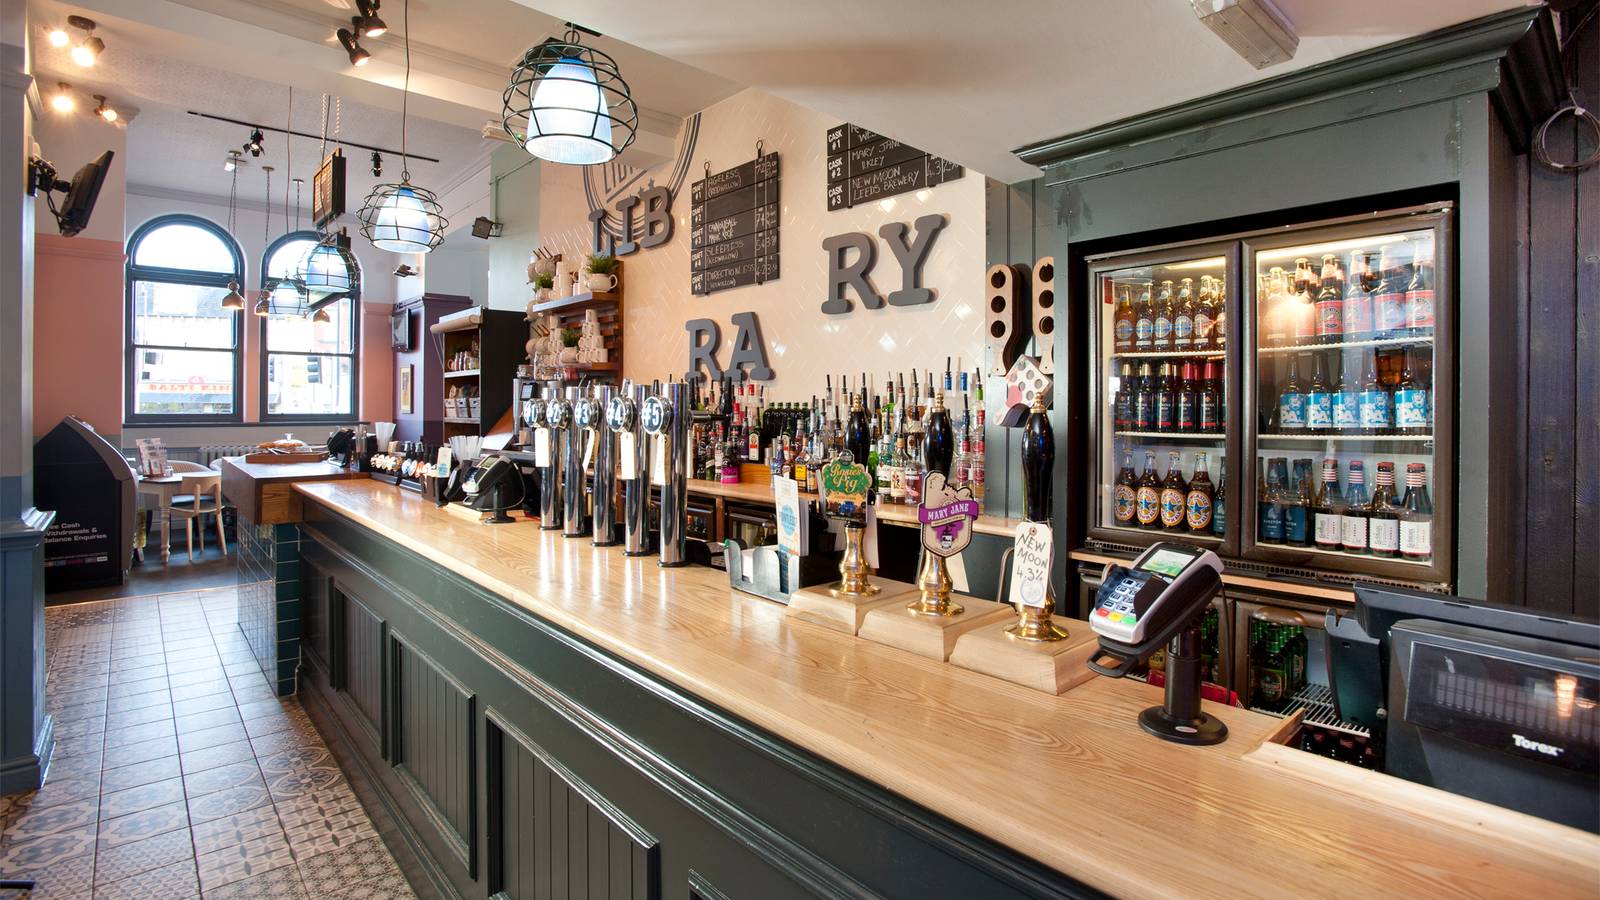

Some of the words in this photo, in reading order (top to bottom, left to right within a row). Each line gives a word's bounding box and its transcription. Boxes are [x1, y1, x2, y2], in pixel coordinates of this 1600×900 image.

[828, 129, 843, 143] CASK
[831, 140, 841, 151] #1
[828, 157, 843, 171] CASK
[831, 167, 842, 179] #2
[852, 177, 871, 190] NEW
[873, 166, 901, 184] MOON
[828, 184, 843, 198] CASK
[853, 185, 881, 200] LEEDS
[883, 170, 920, 191] BREWERY
[831, 194, 842, 206] #3
[588, 186, 673, 258] LIB
[692, 228, 704, 239] CRAFT
[695, 236, 702, 246] #3
[692, 251, 704, 262] CRAFT
[695, 259, 702, 268] #4
[821, 214, 947, 314] RY
[692, 274, 704, 284] CRAFT
[695, 282, 702, 292] #5
[684, 311, 776, 383] RA
[524, 401, 537, 425] #1
[575, 401, 589, 426] #3
[607, 400, 622, 424] #4
[641, 402, 660, 426] #5
[928, 508, 949, 520] MARY
[951, 503, 969, 515] JANE
[74, 533, 107, 541] Enquiries
[1016, 532, 1047, 553] NEW
[1017, 547, 1049, 569] MOON
[1016, 566, 1044, 582] 4.3%
[1512, 733, 1560, 757] Torex
